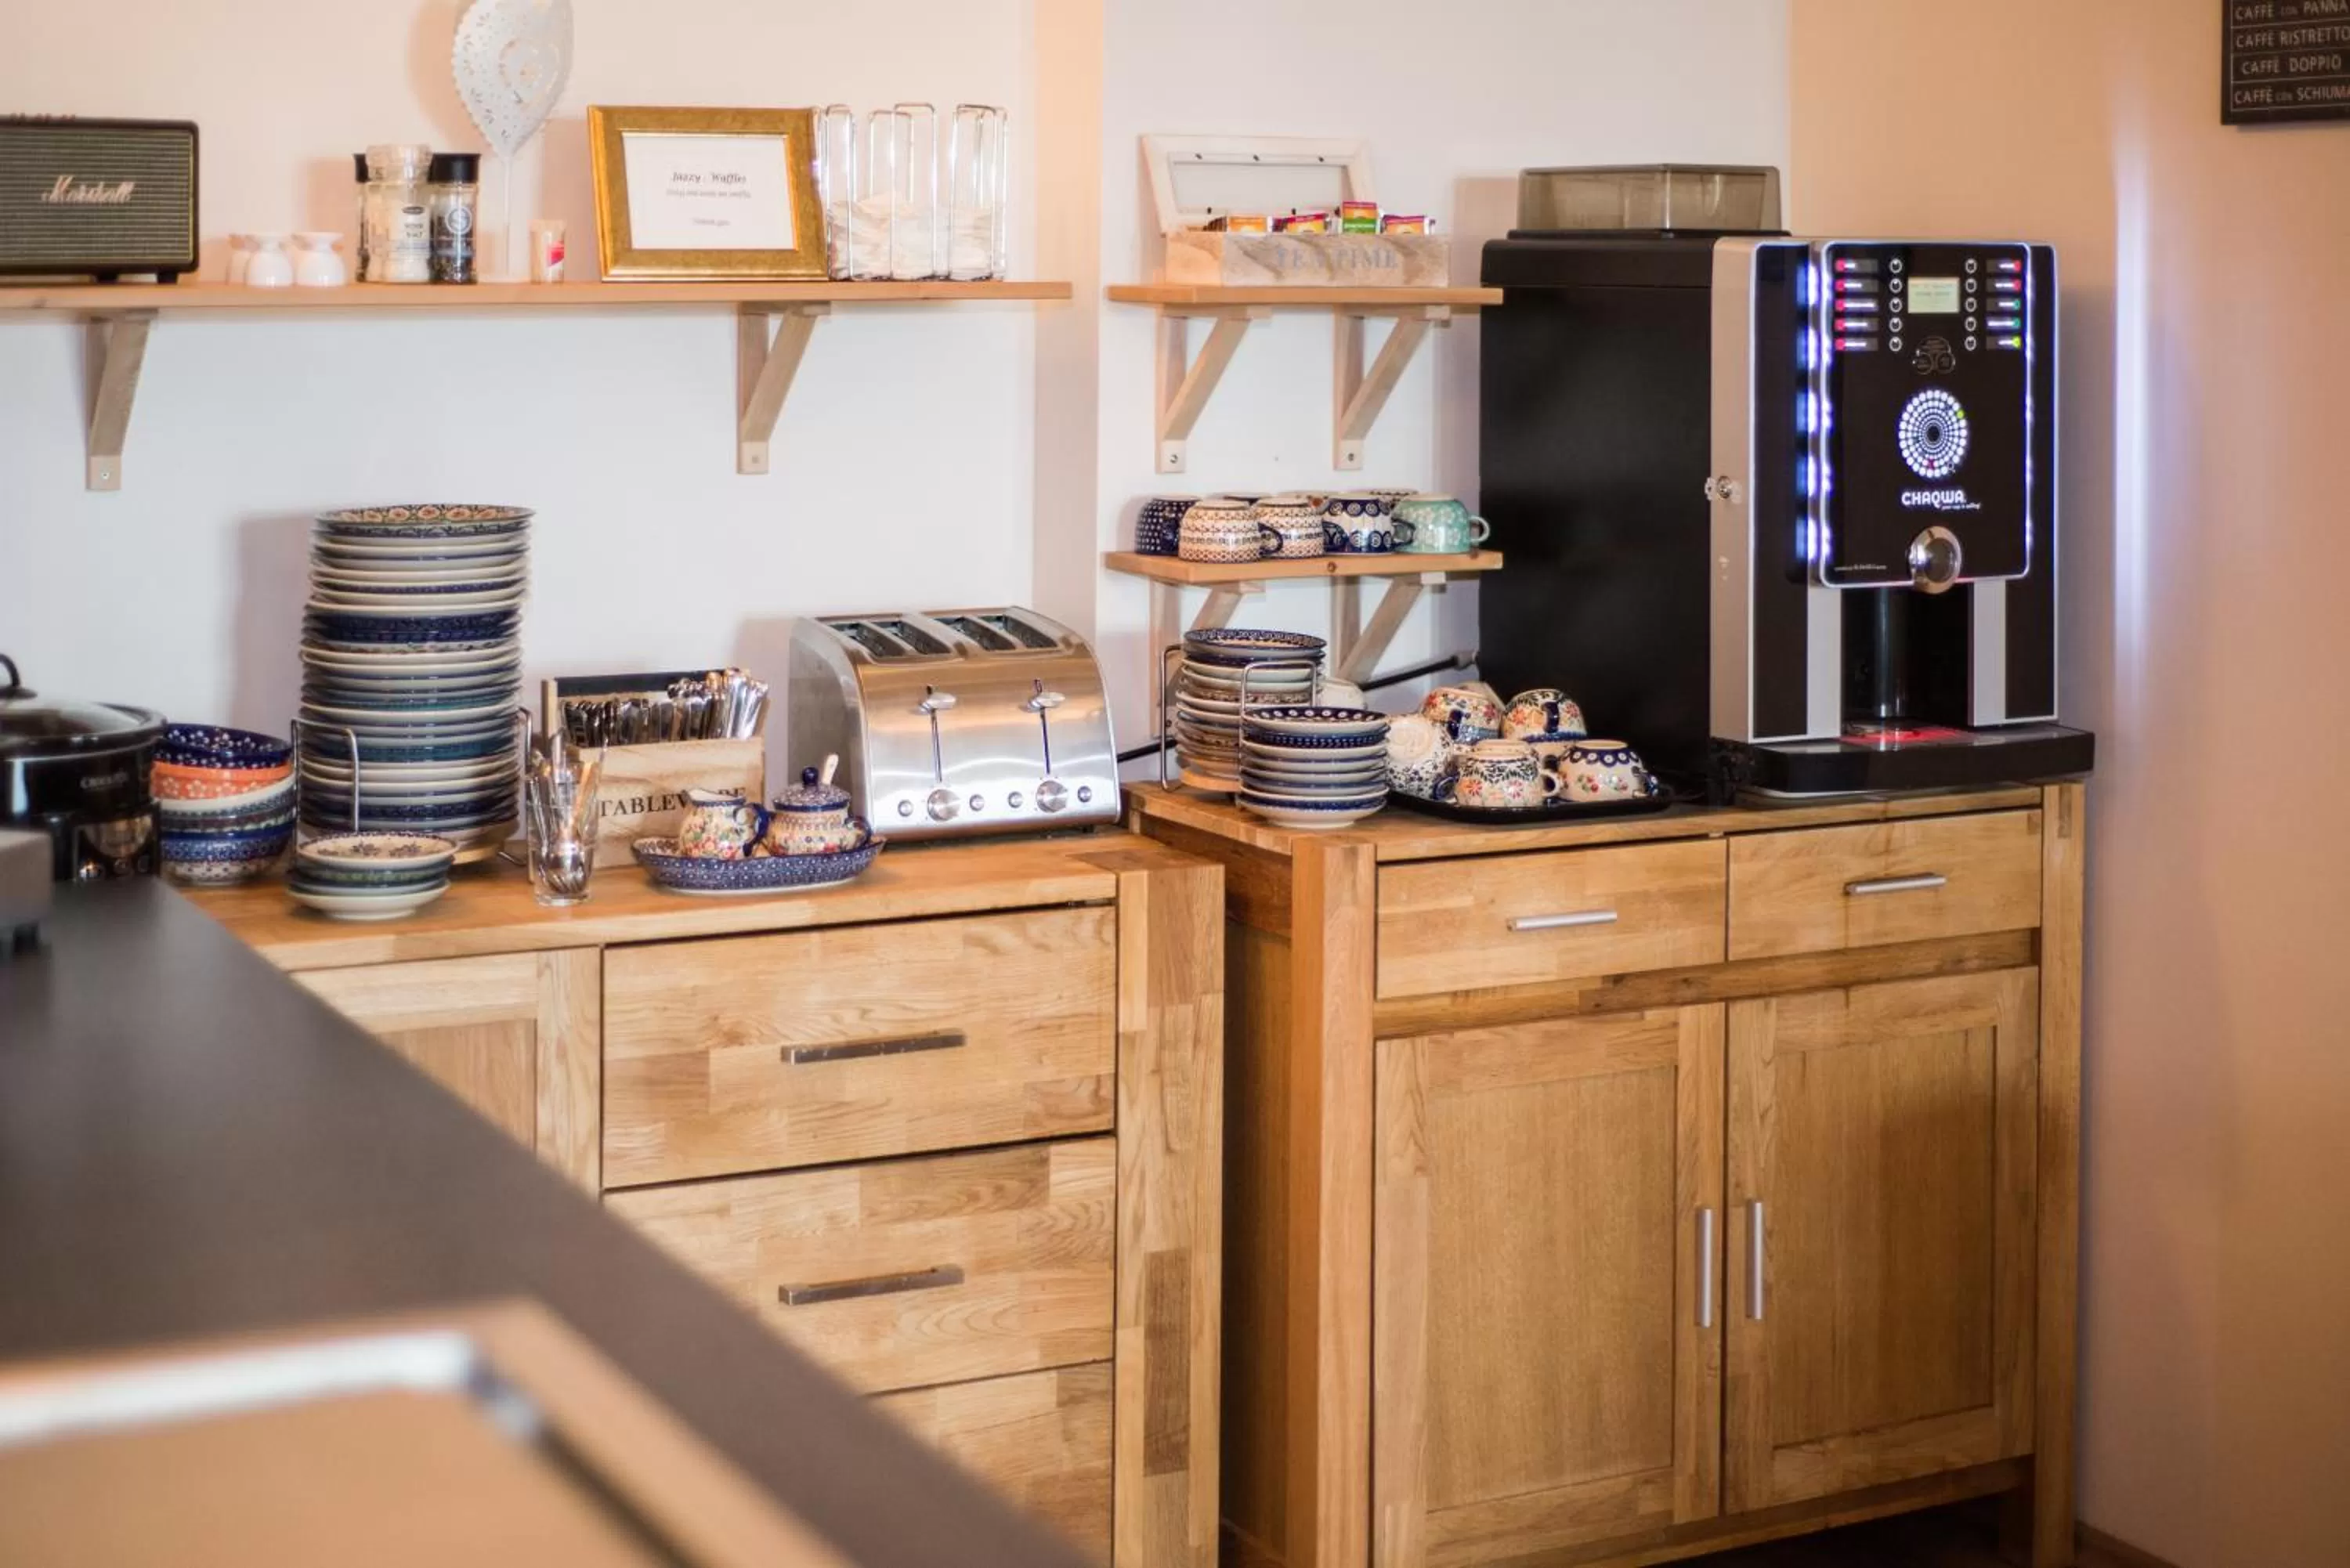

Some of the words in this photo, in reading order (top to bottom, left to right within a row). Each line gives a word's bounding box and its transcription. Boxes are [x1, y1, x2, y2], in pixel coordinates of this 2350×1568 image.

[2280, 25, 2350, 46] RISTRETTO
[2289, 54, 2342, 72] DOPPIO
[41, 175, 136, 205] Marshall
[599, 787, 745, 817] TABLEE
